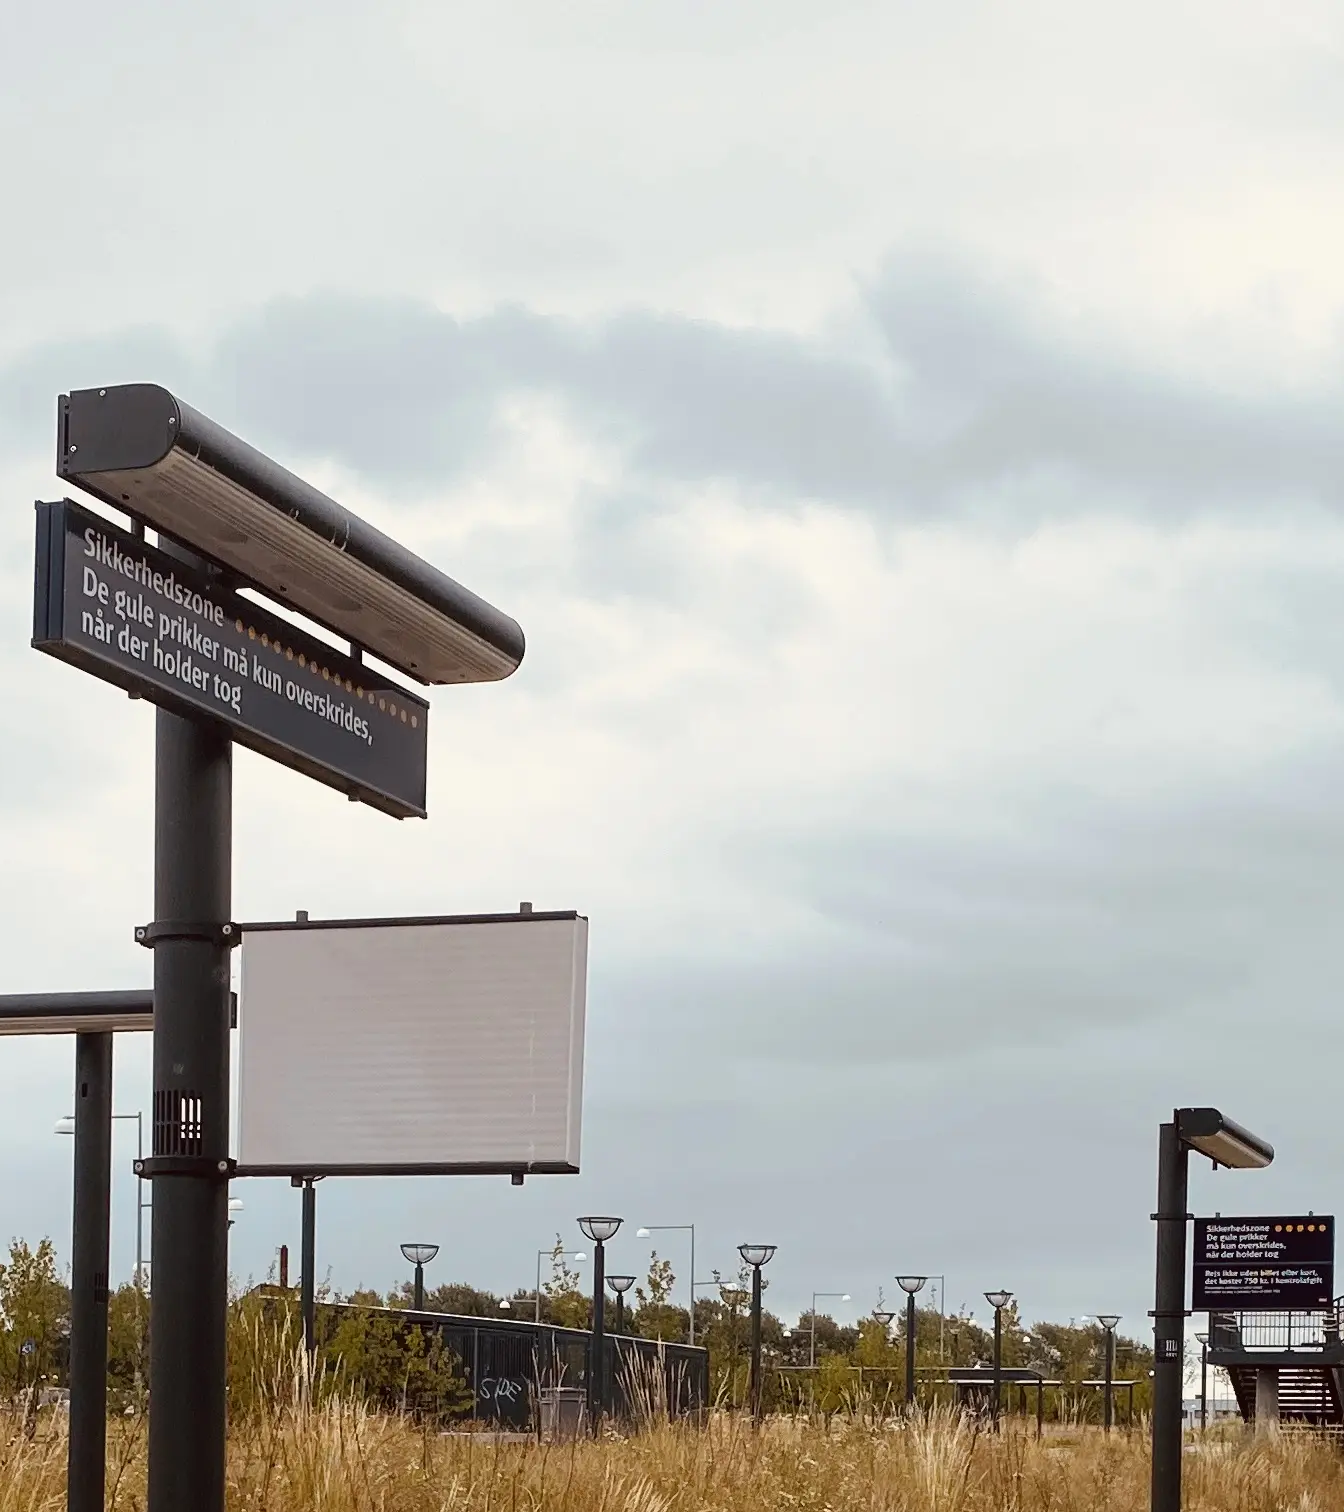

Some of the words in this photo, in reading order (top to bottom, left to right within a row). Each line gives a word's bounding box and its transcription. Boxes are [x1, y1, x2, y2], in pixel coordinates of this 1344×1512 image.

[83, 527, 225, 628] Sikkerhedszone
[82, 608, 112, 645] når
[118, 622, 149, 662] der
[153, 639, 209, 693] holder
[213, 673, 242, 715] tog
[83, 566, 109, 605] De
[114, 588, 154, 628] gule
[159, 613, 220, 662] prikker
[223, 644, 248, 678] må
[254, 655, 282, 695] kun
[286, 679, 374, 746] overskrides,
[1206, 1234, 1217, 1242] De
[1220, 1233, 1237, 1242] gule
[1239, 1233, 1268, 1242] prikker
[1236, 1250, 1263, 1258] holder
[1264, 1250, 1279, 1259] tog
[1238, 1241, 1287, 1250] overskrides,
